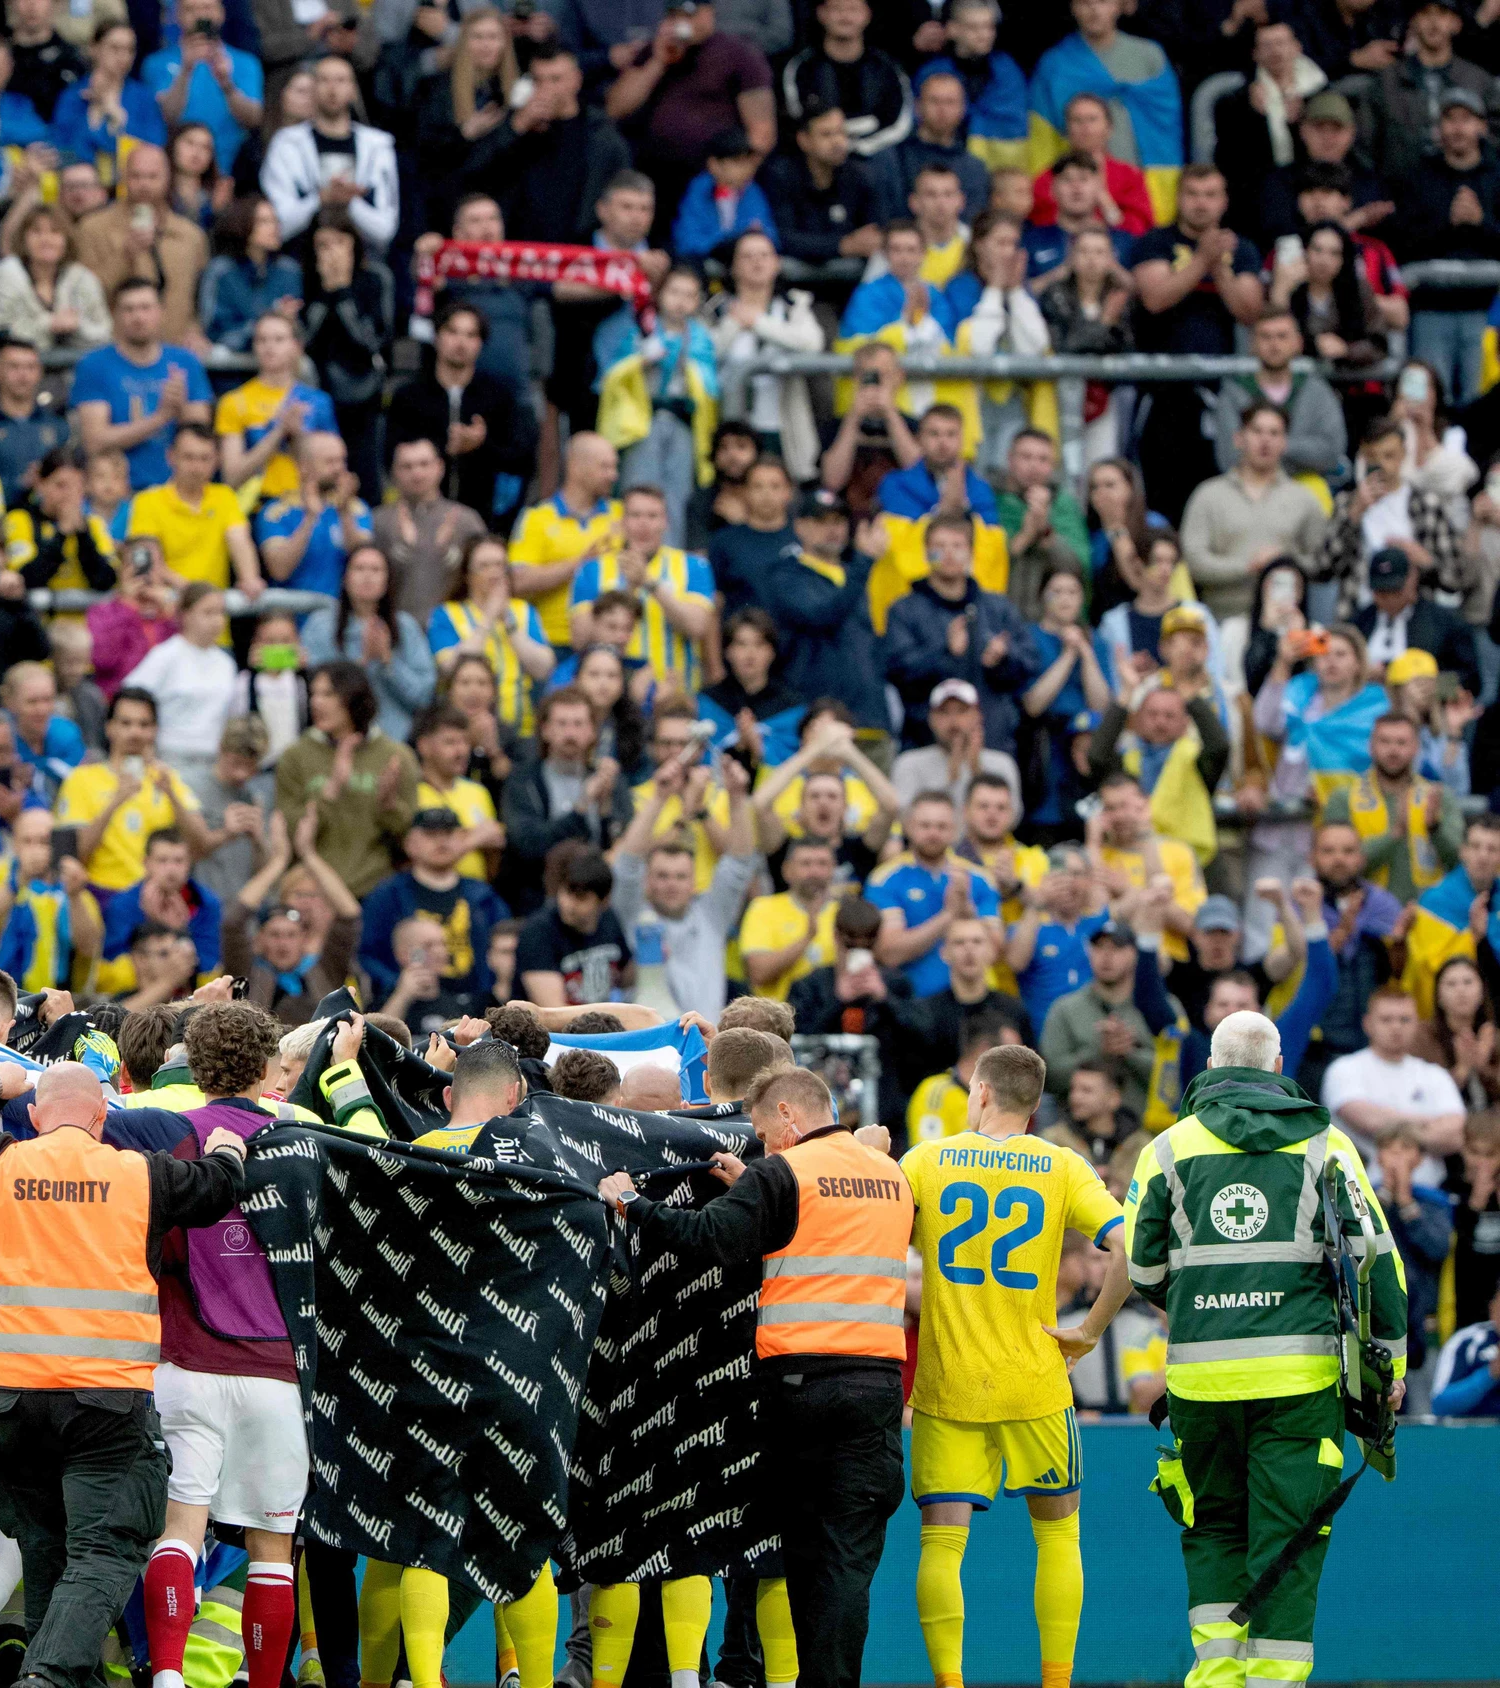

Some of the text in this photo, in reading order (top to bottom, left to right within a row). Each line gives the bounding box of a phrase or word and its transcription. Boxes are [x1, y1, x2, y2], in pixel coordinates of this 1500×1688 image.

[939, 1148, 1052, 1173] MATVIYENKO
[13, 1178, 111, 1203] SECURITY
[817, 1176, 900, 1201] SECURITY
[1219, 1185, 1260, 1201] DANSK
[1213, 1207, 1266, 1238] FOLKEHJÆLP
[938, 1181, 1045, 1290] 22
[1194, 1291, 1285, 1310] SAMARIT
